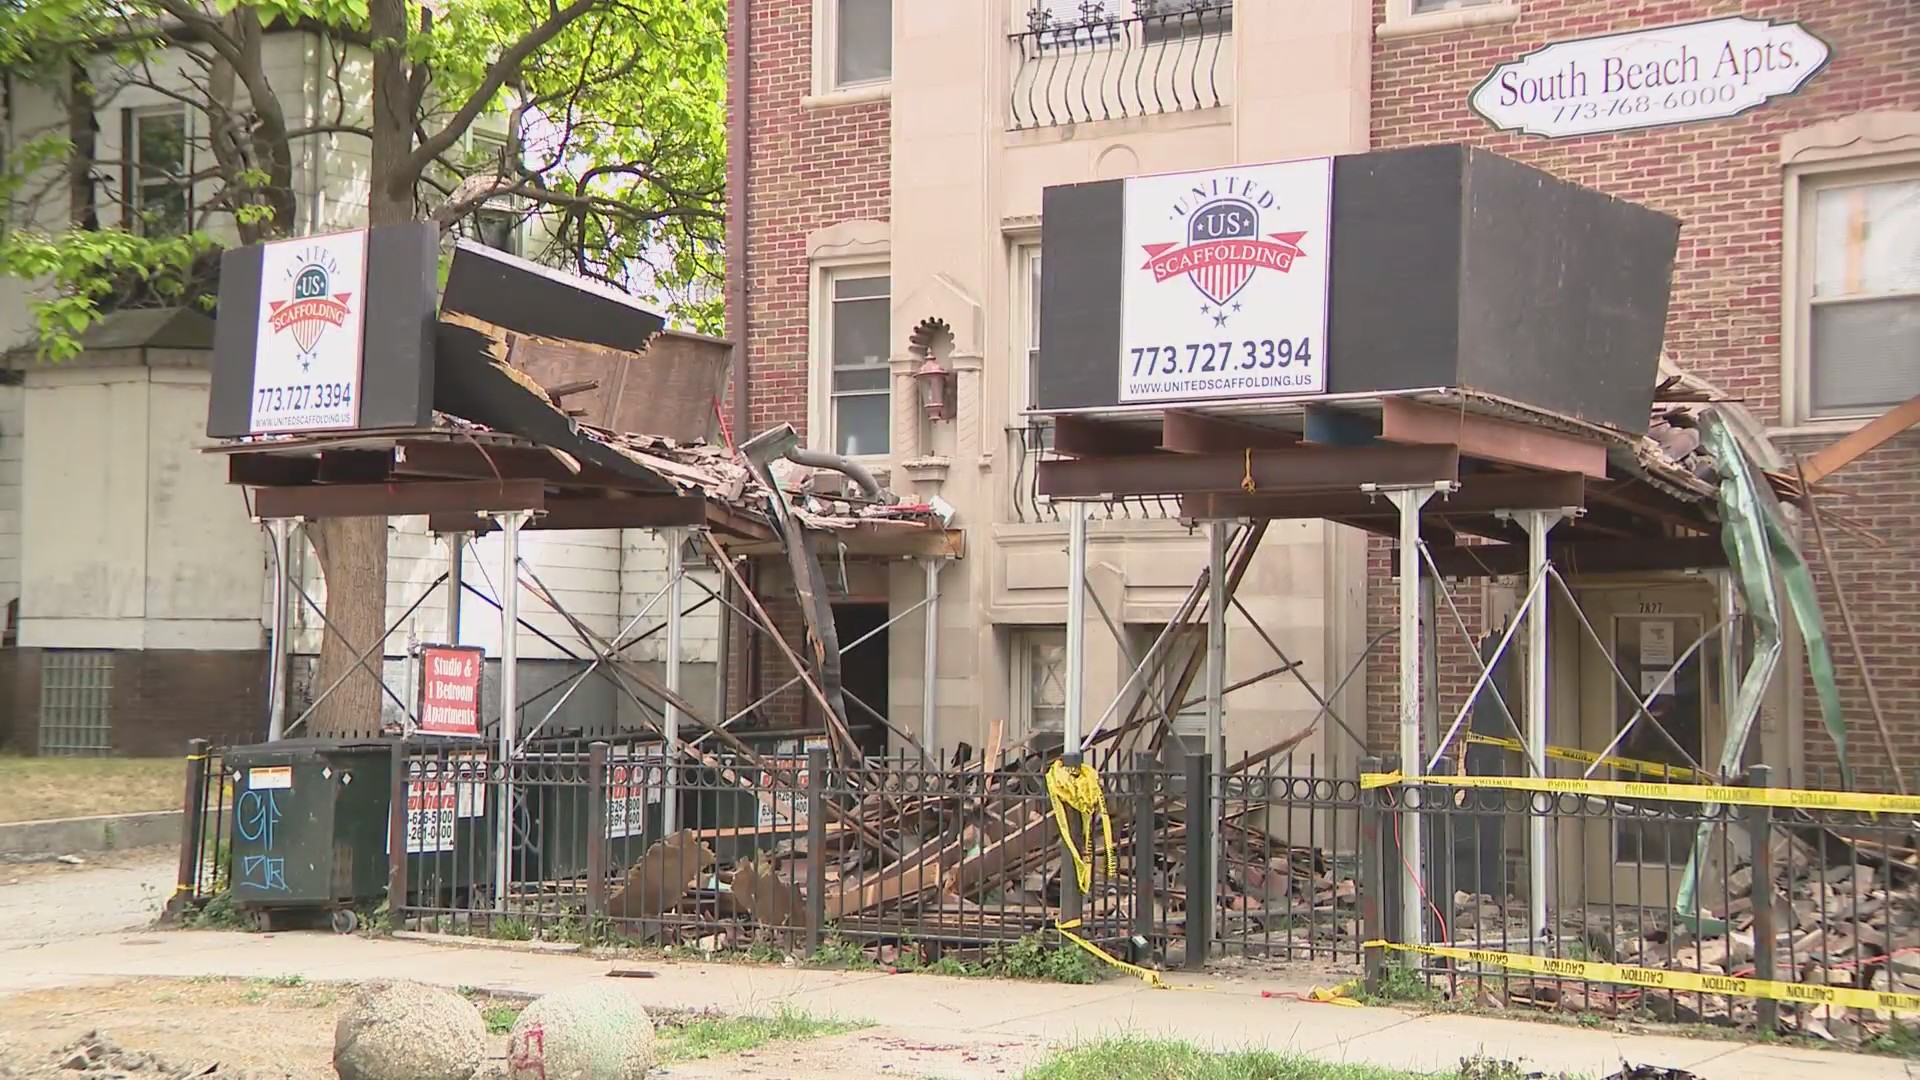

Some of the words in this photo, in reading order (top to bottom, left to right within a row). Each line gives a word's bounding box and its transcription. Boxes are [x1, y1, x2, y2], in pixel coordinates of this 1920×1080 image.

[1500, 61, 1587, 107] South
[1602, 45, 1699, 94] Beach
[1713, 38, 1801, 86] Apts.
[1552, 84, 1737, 124] 773-768-6000
[1173, 176, 1275, 217] UNITED
[1206, 212, 1242, 236] US
[1154, 244, 1292, 280] SCAFFOLDING
[302, 275, 321, 297] US
[274, 302, 345, 331] SCAFFOLDING
[1130, 337, 1312, 377] 773.727.3394
[257, 382, 351, 413] 773.727.3394
[1129, 375, 1313, 395] WWW.UNITEDSCAFFOLDING.US
[433, 656, 462, 677] Studio
[463, 658, 473, 678] &
[428, 680, 434, 699] 1
[435, 680, 474, 702] Bedroom
[424, 703, 475, 726] Apartments
[1468, 950, 1509, 965] CAUTION
[1542, 960, 1585, 976] CAUTION
[1620, 968, 1664, 985] CAUTION
[1701, 976, 1747, 993] CAUTION
[1786, 985, 1835, 1001] CAUTION
[1878, 993, 1920, 1010] AUTION
